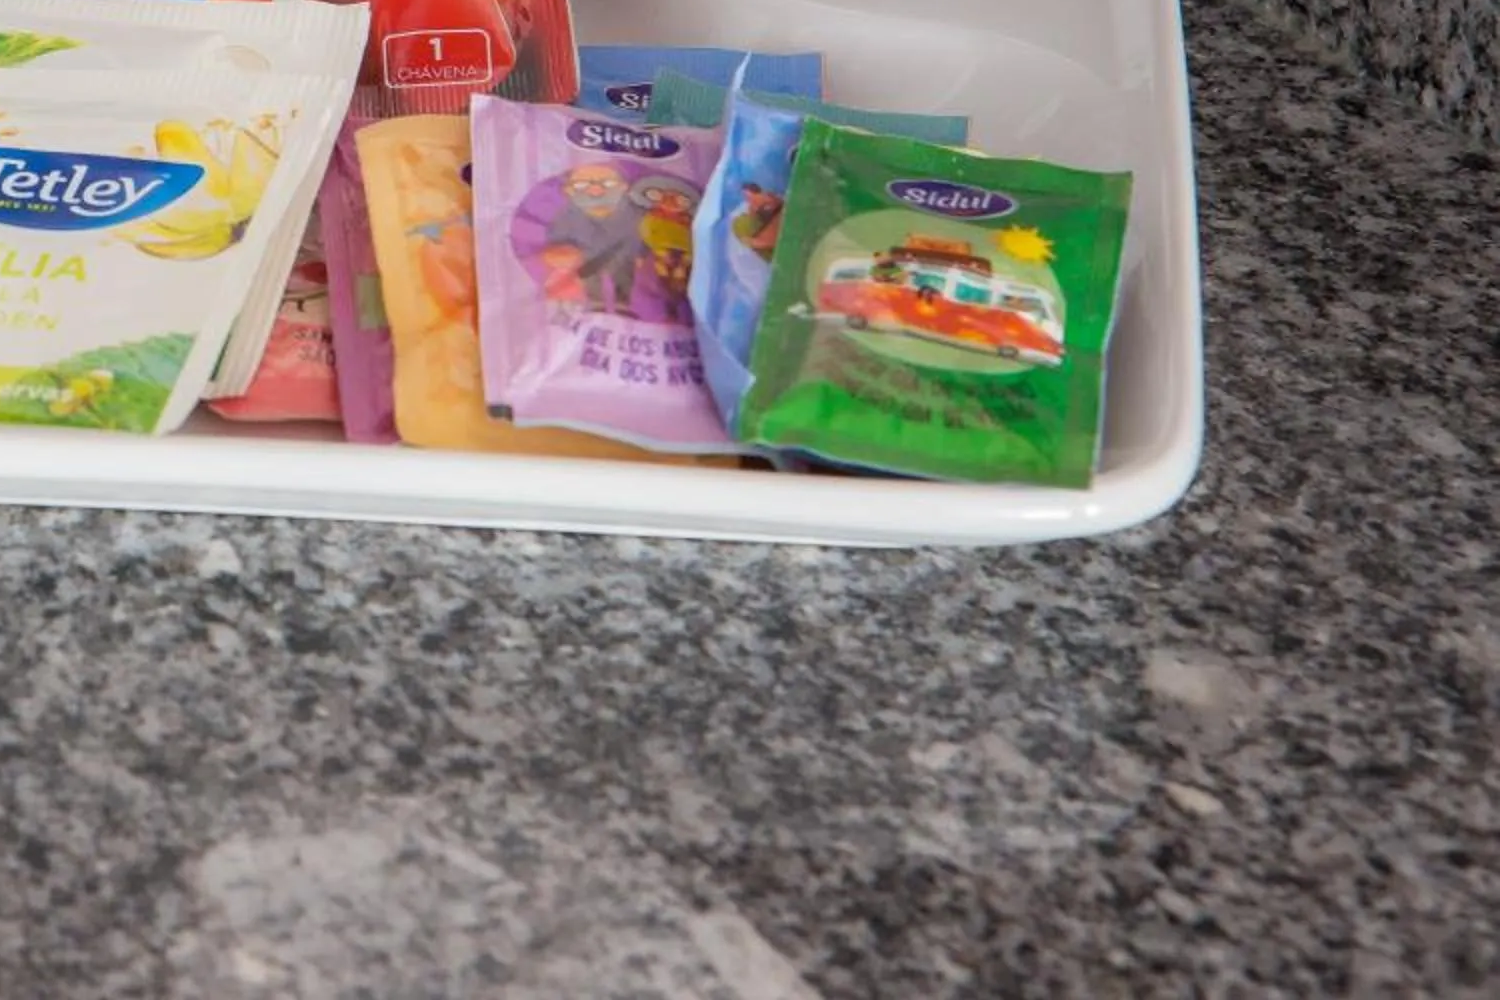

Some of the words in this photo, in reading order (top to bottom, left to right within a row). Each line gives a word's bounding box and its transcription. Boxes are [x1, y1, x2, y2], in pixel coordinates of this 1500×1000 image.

[428, 37, 442, 61] 1
[397, 64, 478, 81] CHÁVENA
[581, 124, 661, 150] Sidul
[903, 187, 992, 210] Sidul
